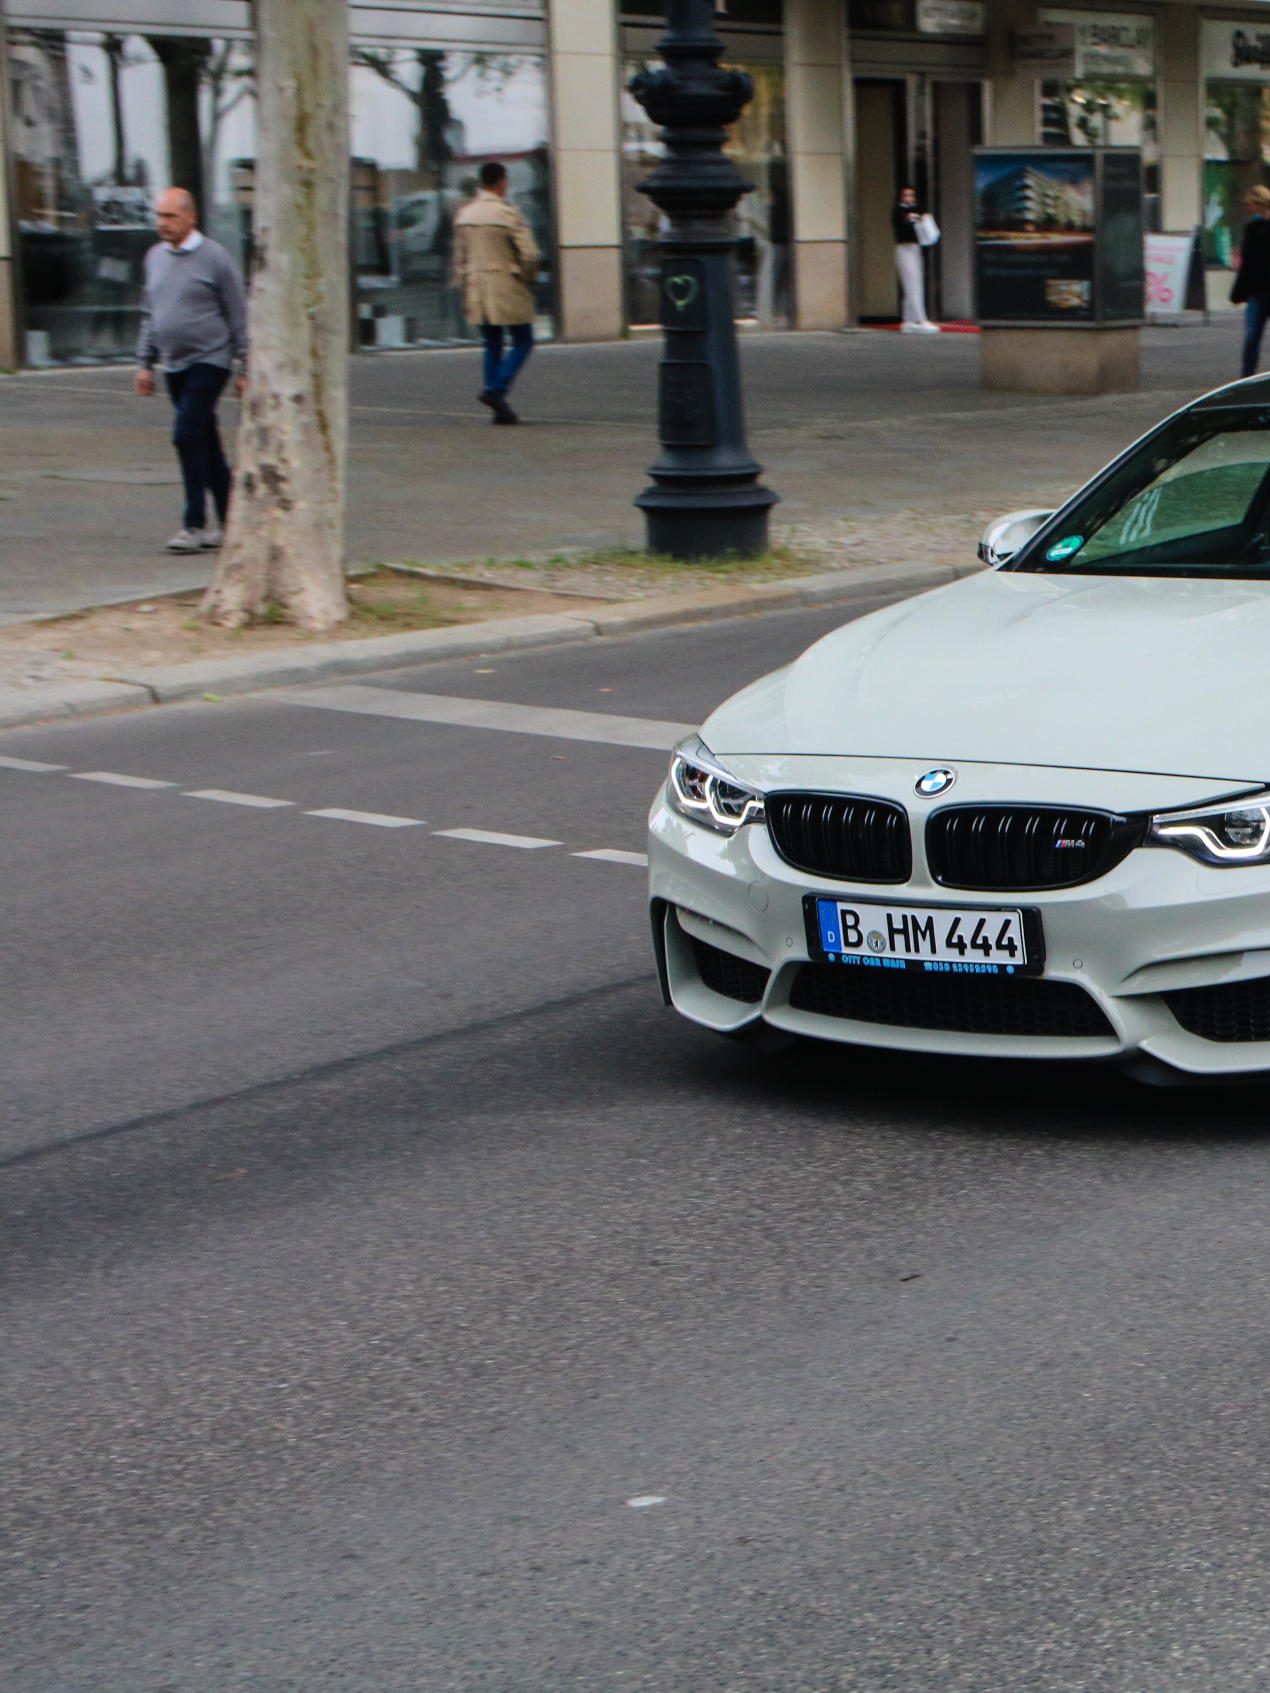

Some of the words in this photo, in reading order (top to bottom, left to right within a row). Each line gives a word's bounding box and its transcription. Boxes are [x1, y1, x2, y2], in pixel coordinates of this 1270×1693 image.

[827, 930, 836, 943] D
[840, 908, 864, 948] B
[886, 912, 937, 954] HM
[945, 916, 1018, 958] 444
